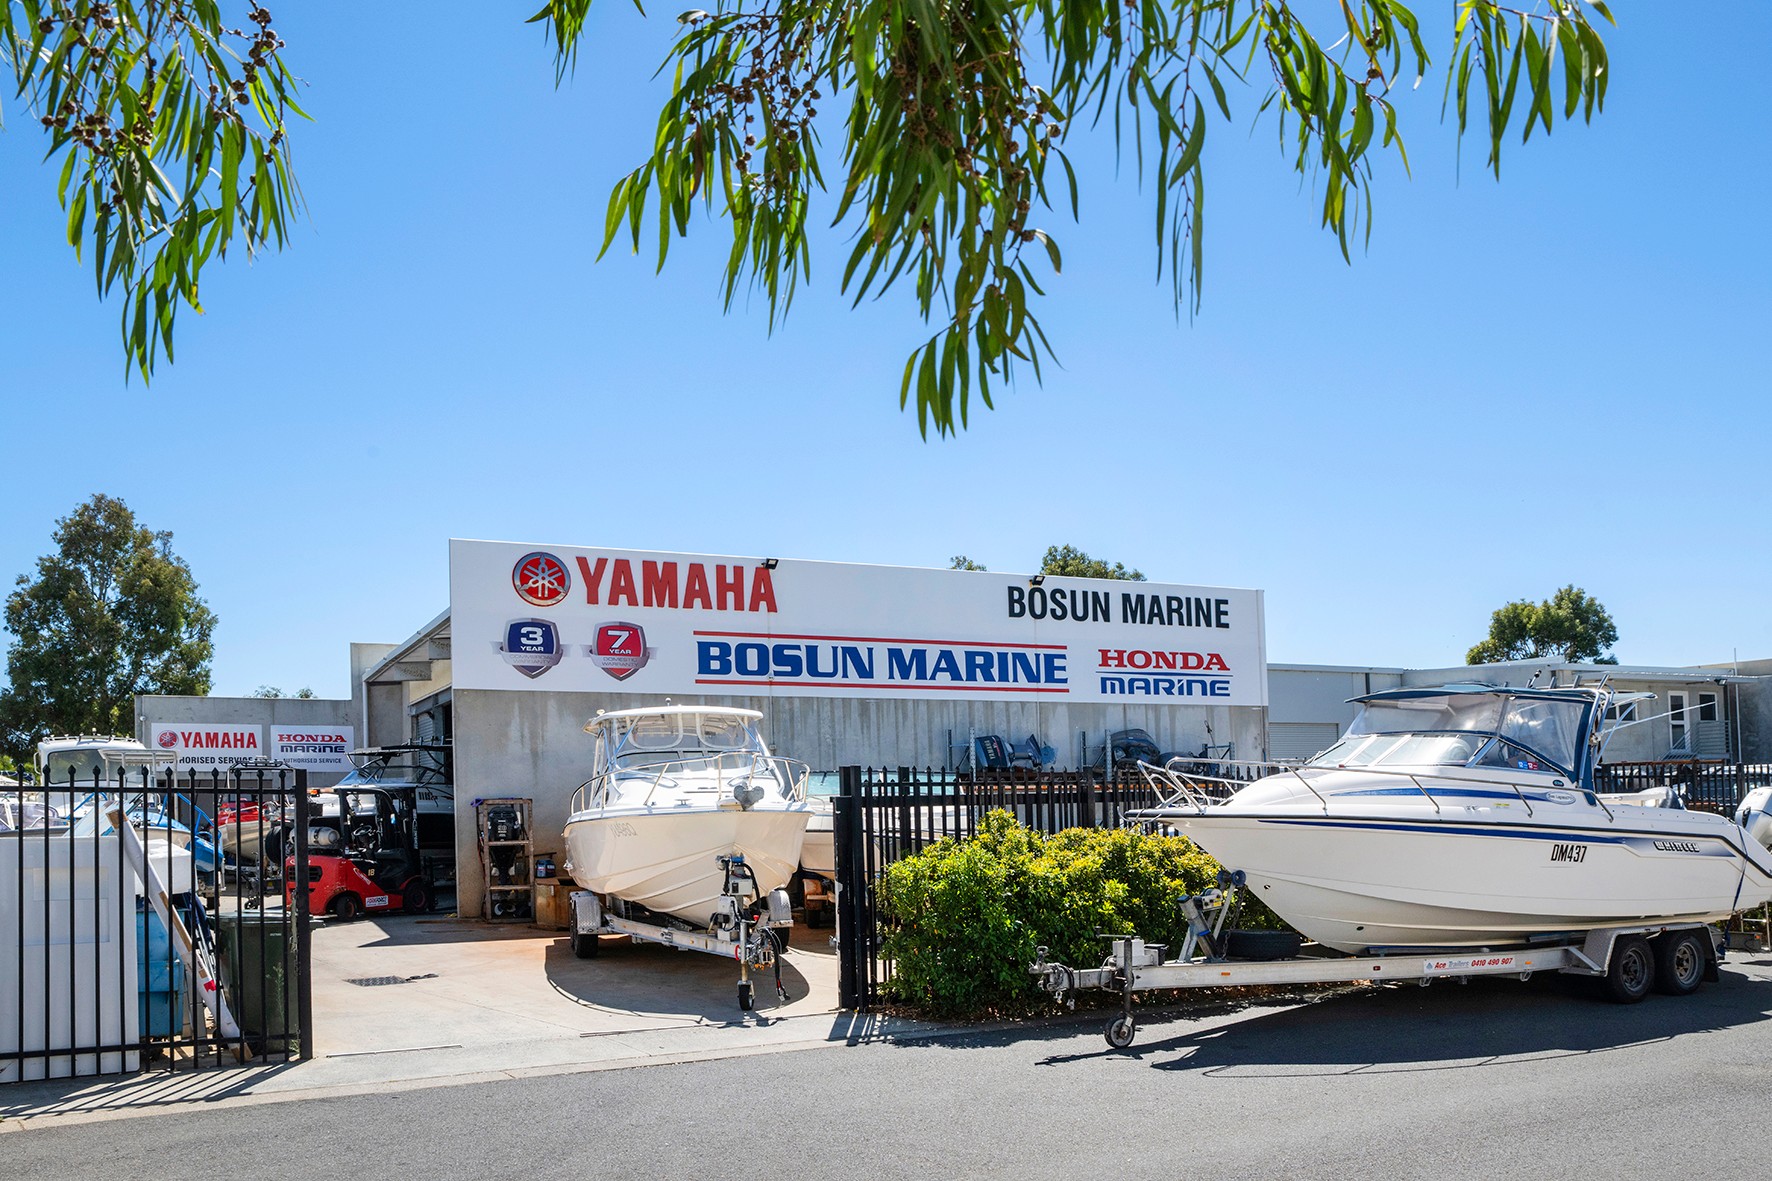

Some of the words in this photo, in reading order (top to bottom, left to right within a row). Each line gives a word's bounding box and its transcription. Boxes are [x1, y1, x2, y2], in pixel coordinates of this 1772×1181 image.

[576, 556, 778, 612] YAMAHA
[1008, 585, 1110, 622] BOSUN
[1122, 593, 1230, 629] MARINE
[520, 626, 543, 645] 3
[607, 630, 630, 648] 7
[697, 641, 874, 681] BOSUN
[888, 648, 1068, 684] MARINE
[1098, 649, 1231, 671] HONDA
[1101, 676, 1231, 697] MARINE
[181, 732, 257, 749] YAMAHA
[278, 734, 347, 742] HONDA
[280, 745, 345, 753] MARINE
[1550, 844, 1588, 863] DM437
[1471, 959, 1487, 967] 0410
[1501, 957, 1513, 965] 907
